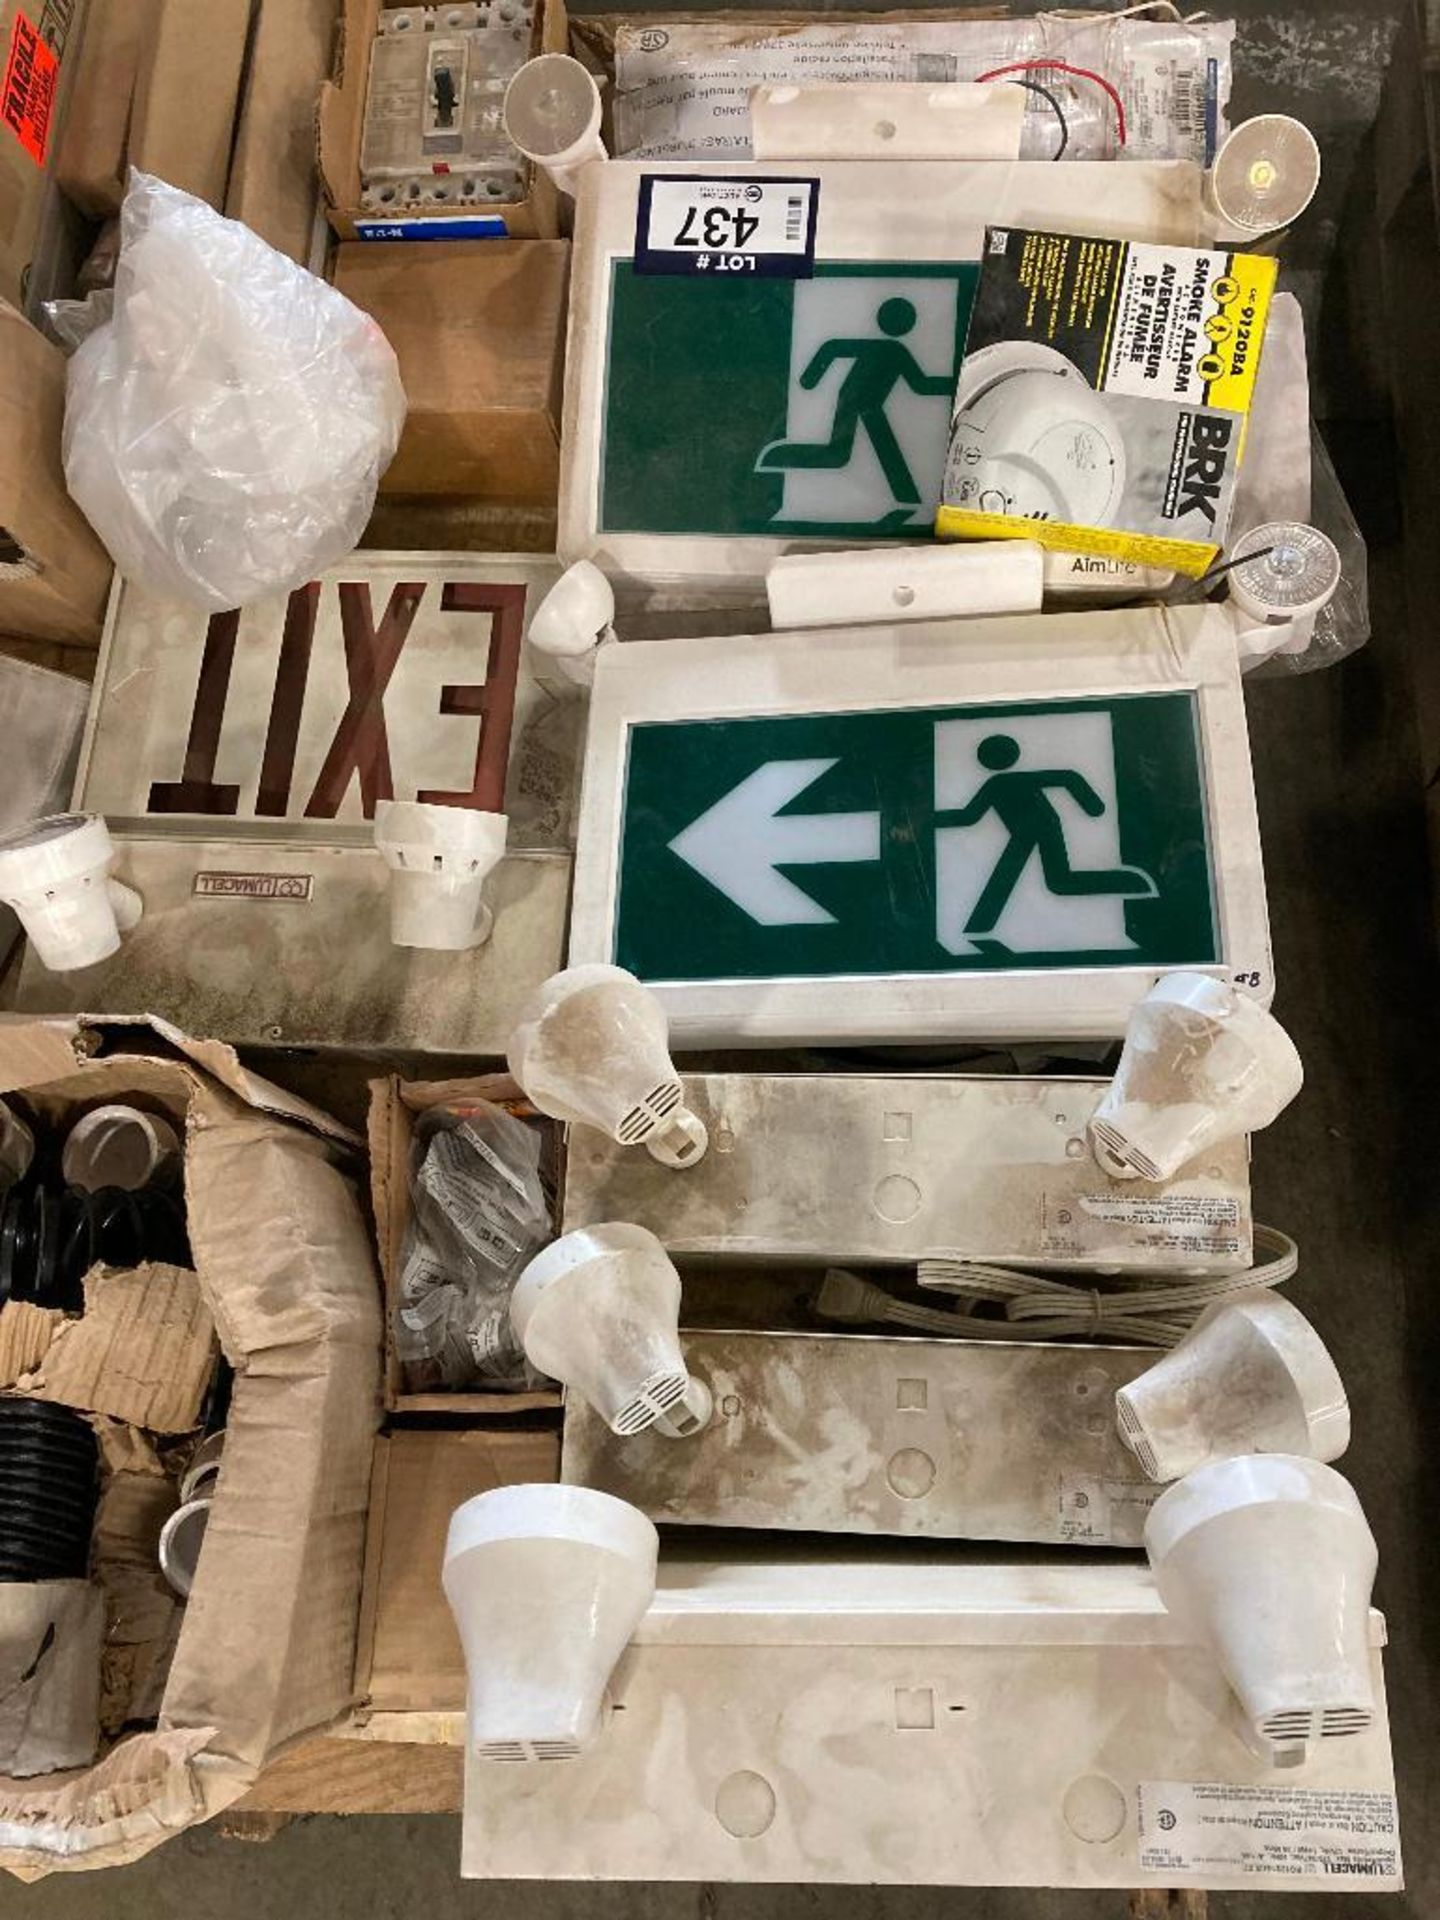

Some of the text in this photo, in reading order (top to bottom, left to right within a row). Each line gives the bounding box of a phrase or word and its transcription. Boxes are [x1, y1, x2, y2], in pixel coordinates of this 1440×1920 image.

[5, 19, 37, 134] FRAGILE
[674, 206, 760, 248] 437
[696, 253, 755, 271] LOT #
[1129, 275, 1158, 363] DE FUMÉE
[1144, 263, 1177, 379] AVERTISSEUR
[1174, 258, 1210, 393] SMOKE ALARM
[1230, 307, 1255, 376] 9120BA
[1177, 413, 1233, 524] BRK
[147, 581, 527, 819] EXIT
[201, 878, 272, 893] LUMACELL
